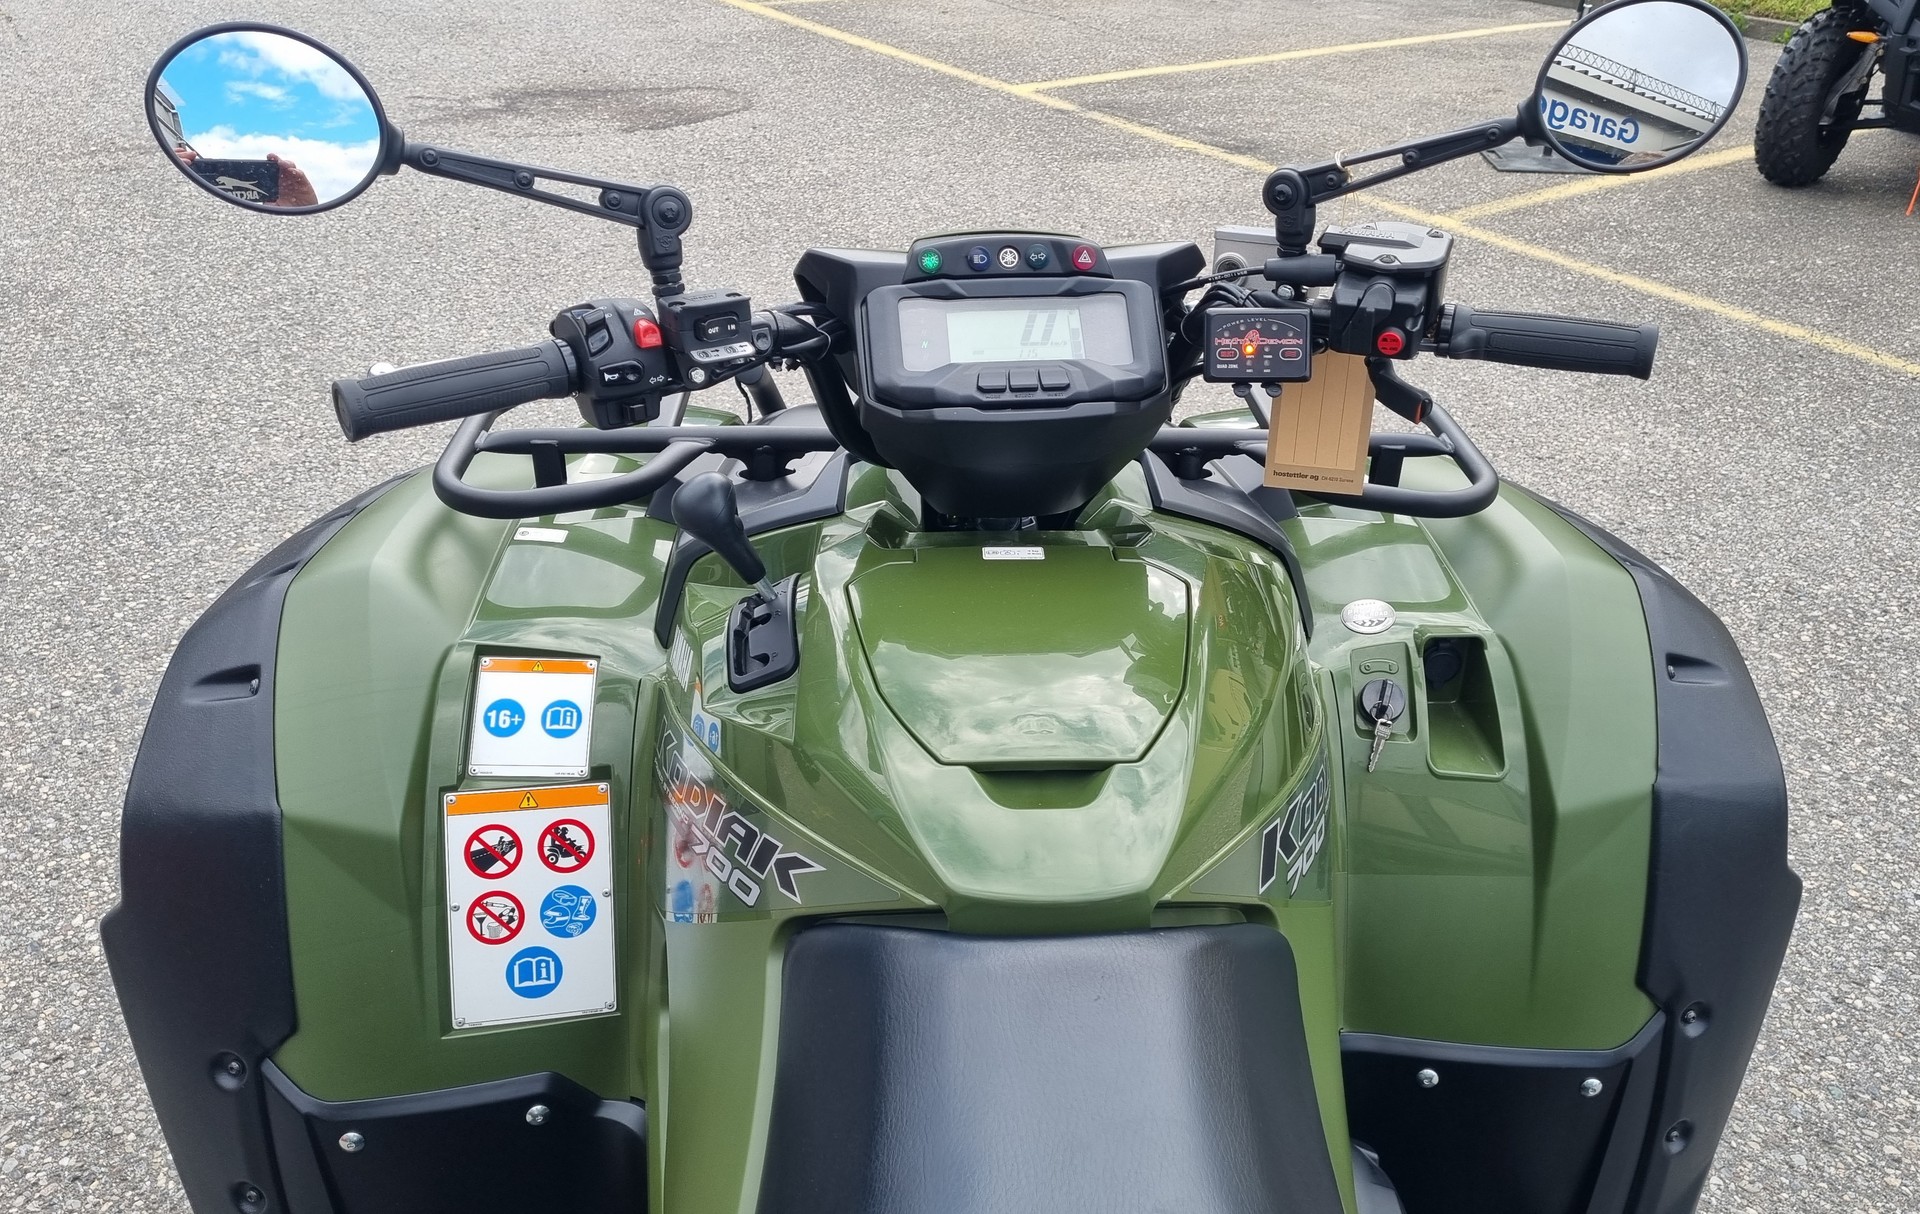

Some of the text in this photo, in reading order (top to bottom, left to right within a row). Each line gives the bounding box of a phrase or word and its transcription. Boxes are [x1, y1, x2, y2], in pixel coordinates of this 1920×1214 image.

[921, 340, 929, 349] N
[1309, 474, 1320, 482] ag
[486, 708, 523, 728] 16+
[691, 824, 762, 907] 700
[1286, 813, 1326, 899] 700
